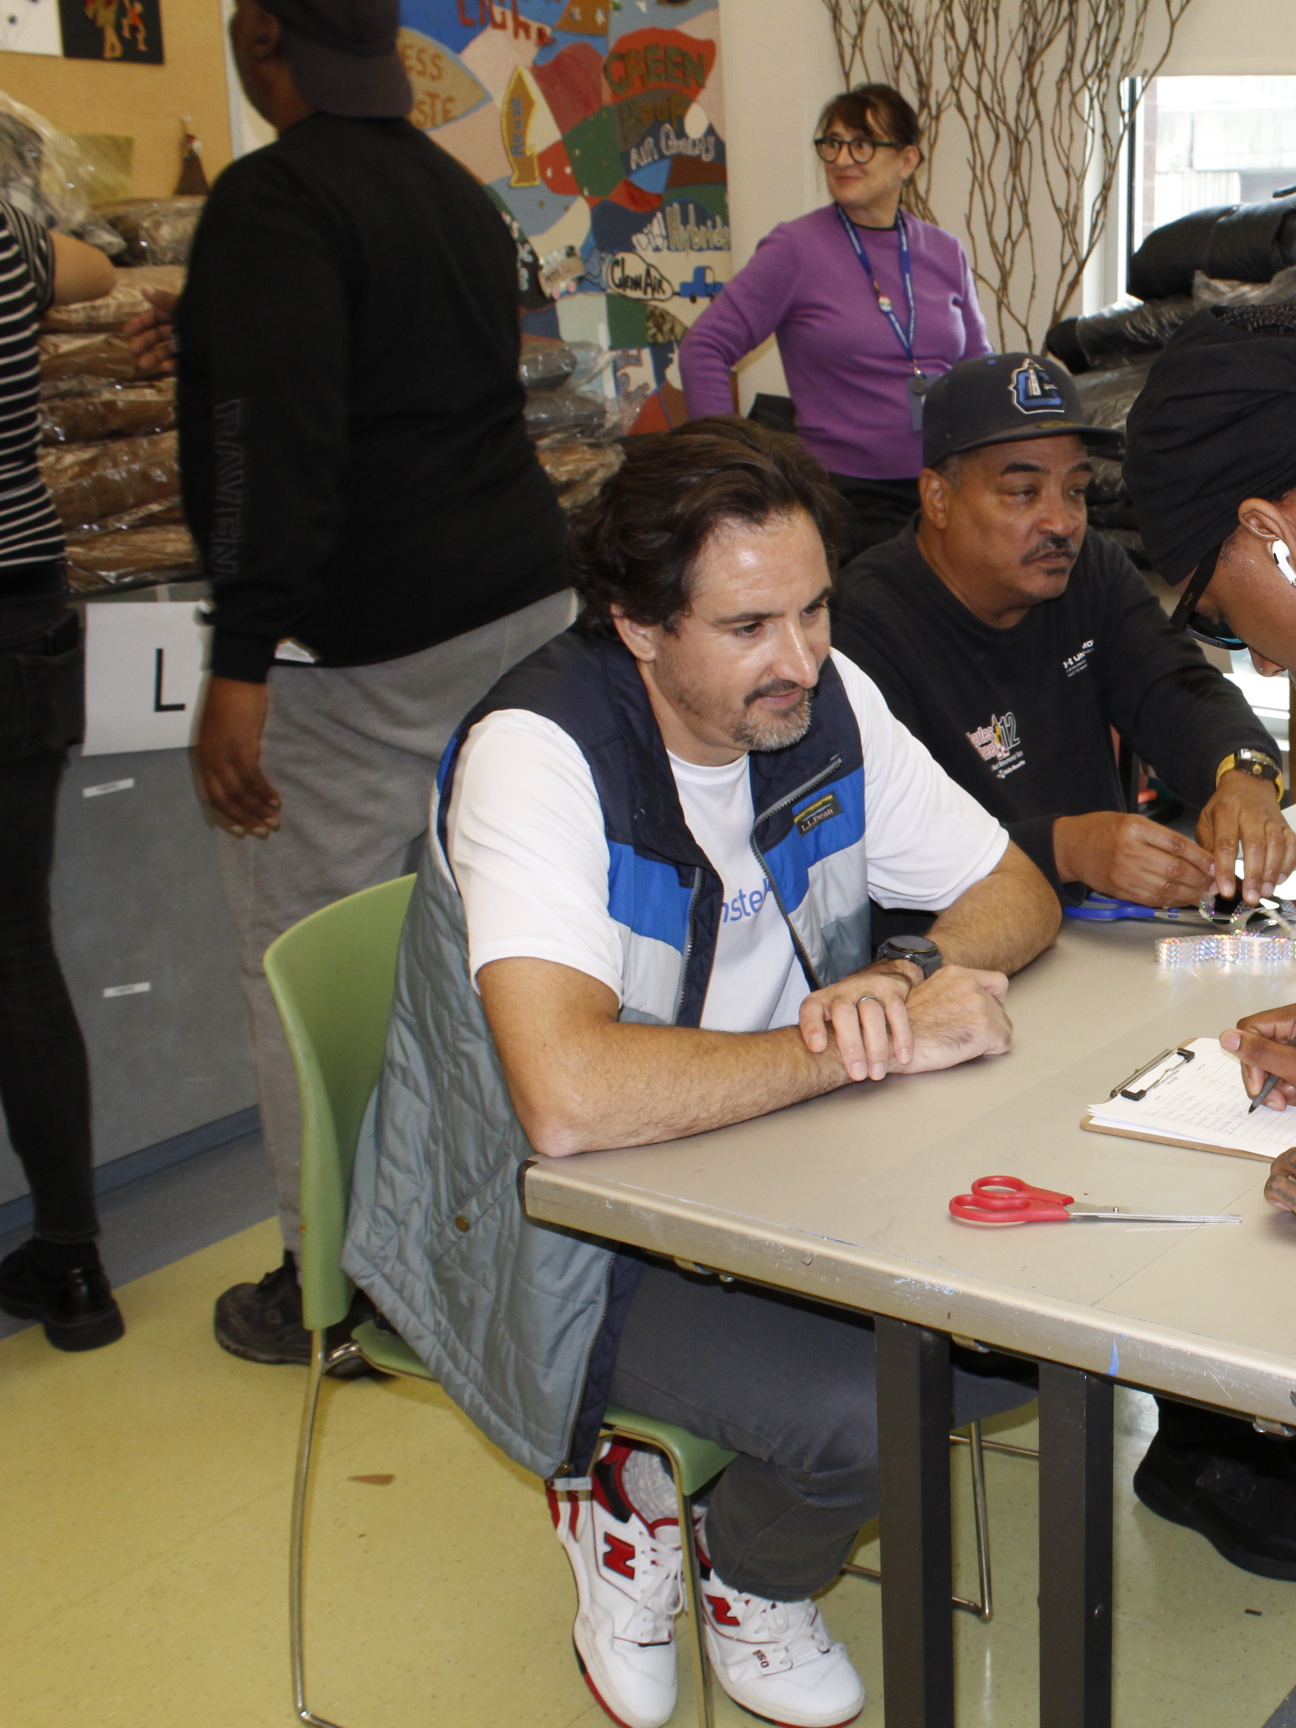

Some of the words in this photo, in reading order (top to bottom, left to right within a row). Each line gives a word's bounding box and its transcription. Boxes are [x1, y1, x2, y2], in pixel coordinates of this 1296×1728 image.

[401, 44, 442, 81] ESS
[603, 44, 705, 94] GREEN
[406, 91, 456, 129] STE
[154, 648, 186, 712] L
